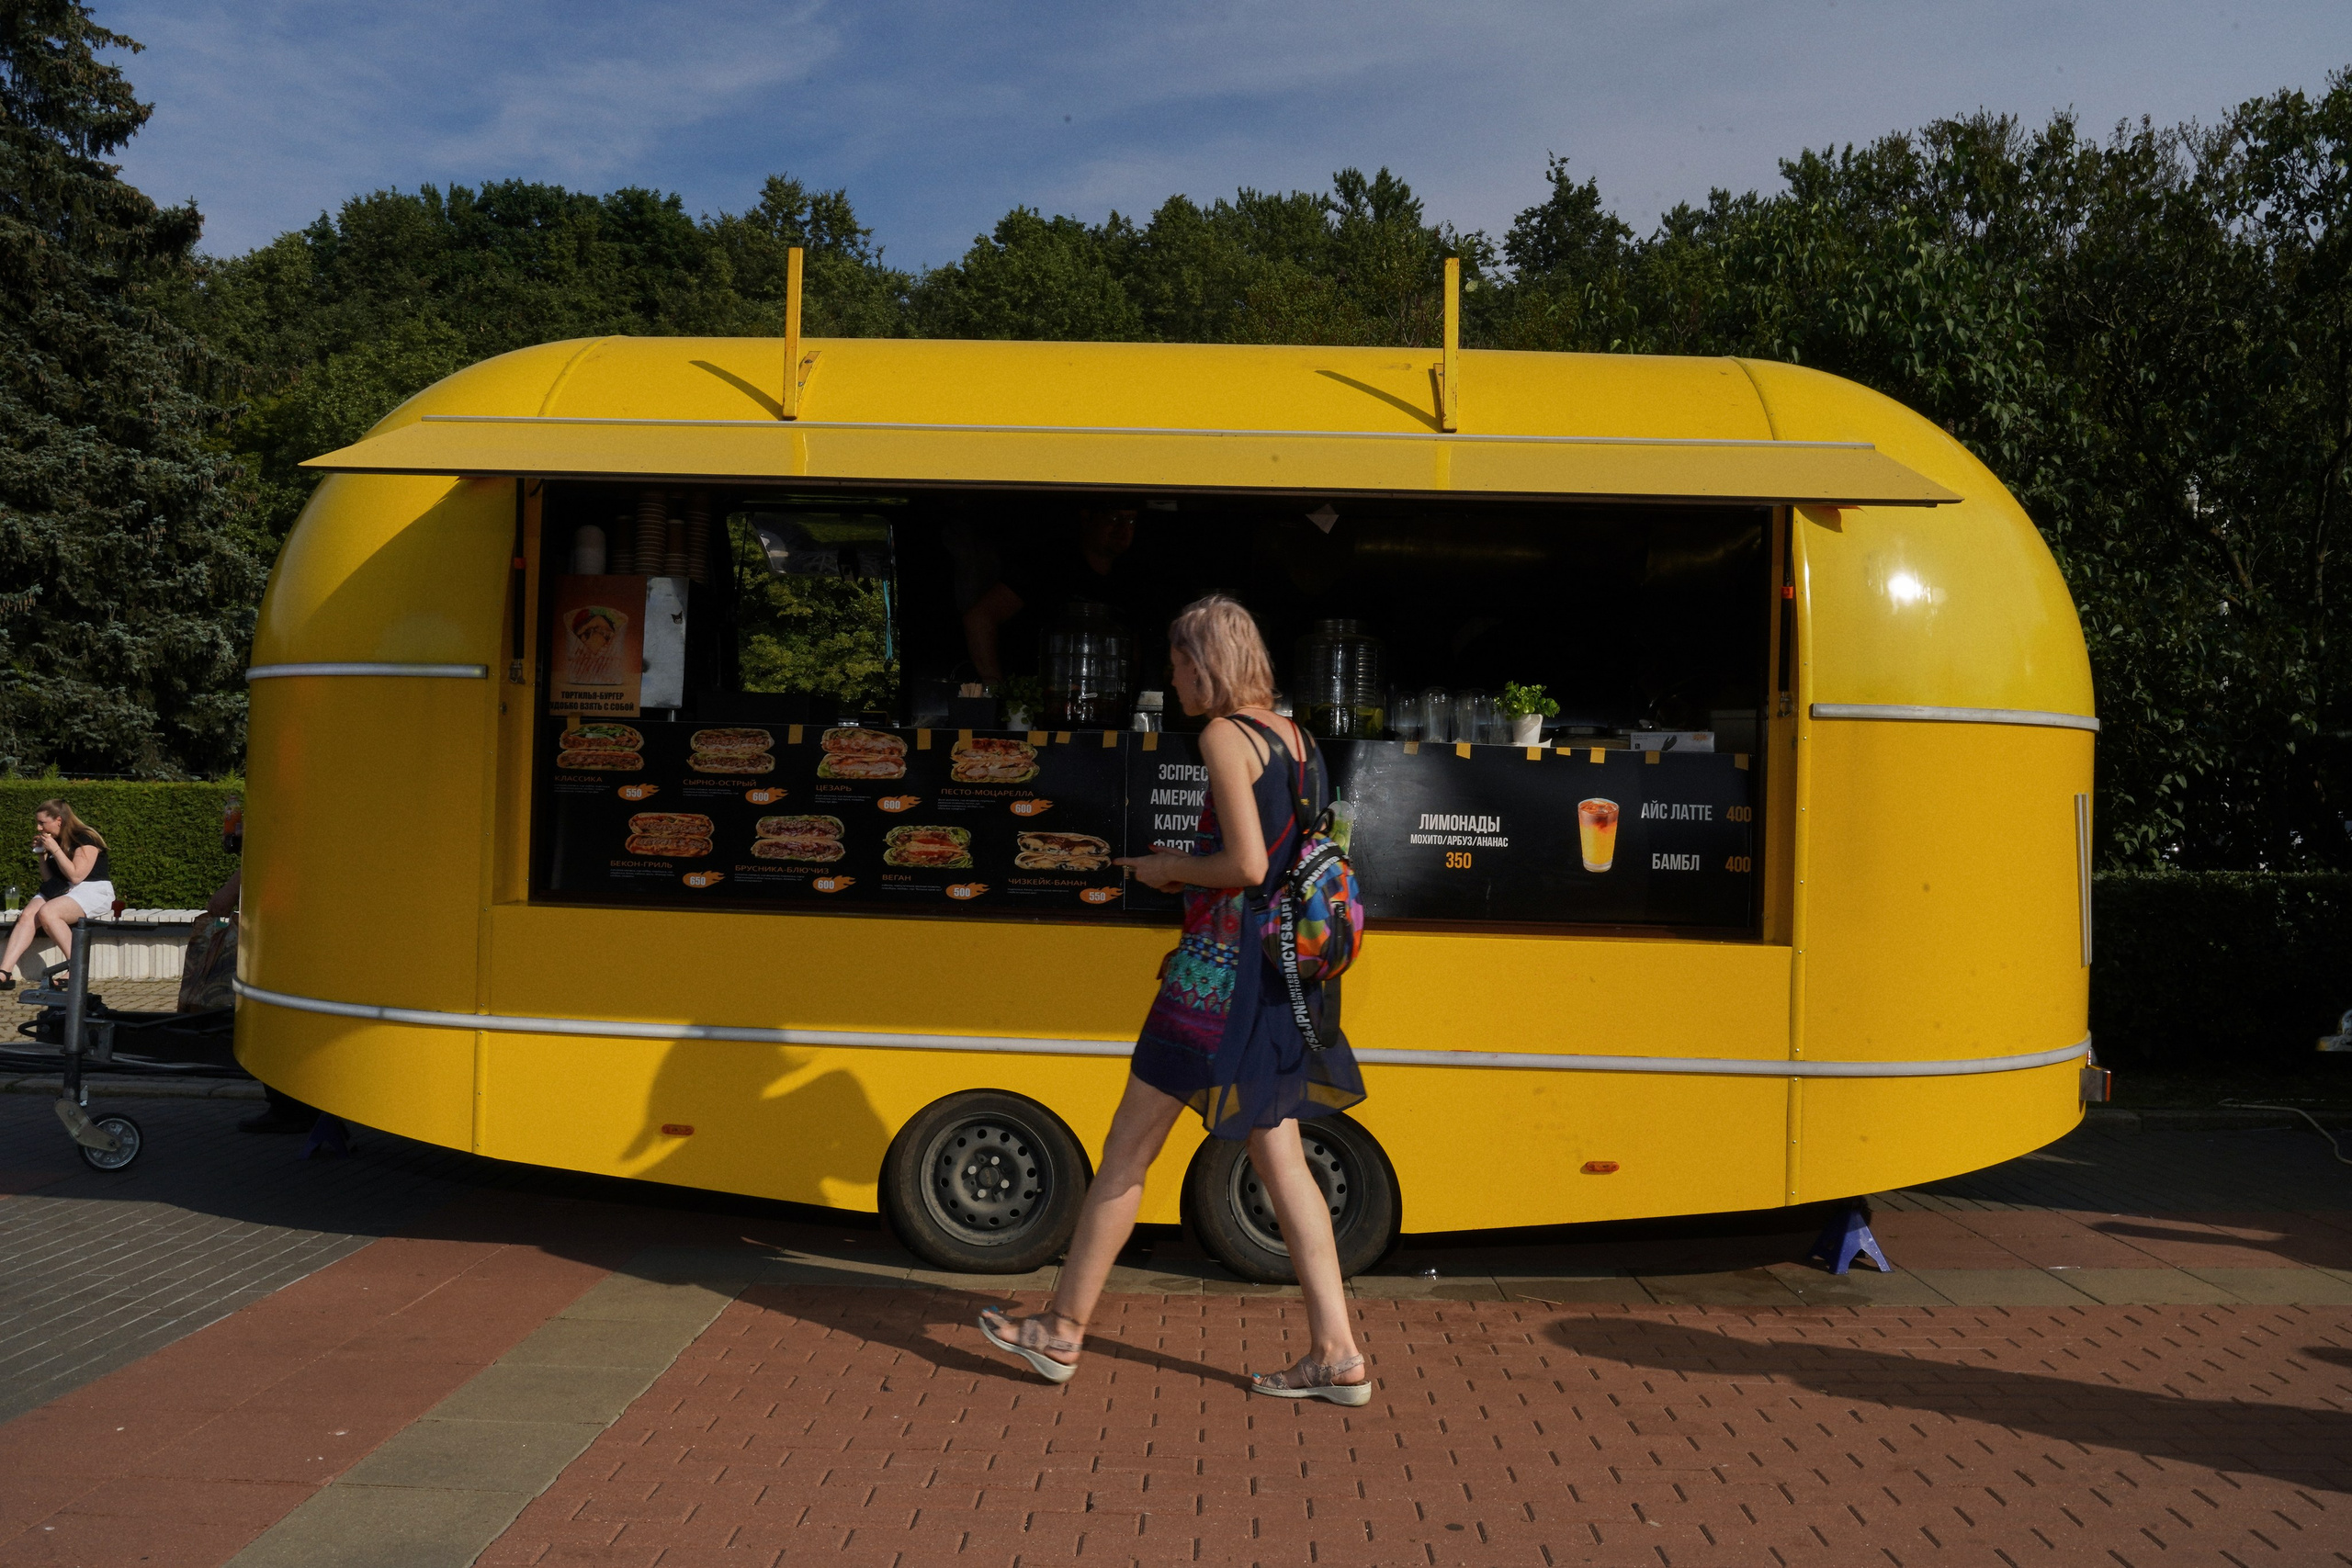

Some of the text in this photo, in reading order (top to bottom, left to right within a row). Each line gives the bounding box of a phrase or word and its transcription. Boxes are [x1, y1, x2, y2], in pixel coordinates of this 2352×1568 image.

[560, 691, 625, 700] ТОРТИЛЬЯ-БУРГЕР
[580, 702, 603, 711] ВЗЯТЬ
[604, 703, 609, 711] С
[610, 702, 634, 711] СОБОЙ
[553, 774, 603, 783] КЛАССИКА
[683, 778, 757, 787] СЫРНО-ОСТРЫЙ
[626, 788, 642, 797] 550
[752, 792, 769, 802] 600
[941, 787, 1035, 797] ПЕСТО-МОЦАРЕЛЛА
[1150, 788, 1204, 807] АМЕРИК
[883, 800, 900, 809] 600
[1015, 804, 1032, 813] 600
[1640, 799, 1752, 823] АЙС ЛАТТЕ 400
[1154, 813, 1202, 831] КАПУЧ
[1419, 813, 1500, 834] ЛИМОНАДЫ
[1410, 833, 1509, 848] МОХИТО/АРБУЗ/АНАНАС
[610, 860, 673, 869] БЕКОН-ГРИЛЬ
[1445, 851, 1472, 869] 350
[1651, 852, 1752, 873] БАМБЛ 400
[689, 875, 706, 886] 650
[817, 879, 834, 889] 600
[1007, 877, 1087, 886] ЧИЗКЕЙК-БАНАН
[953, 887, 970, 897] 500
[1089, 891, 1105, 901] 550
[1286, 974, 1299, 1006] LIMITED
[1293, 974, 1306, 1005] EDITION
